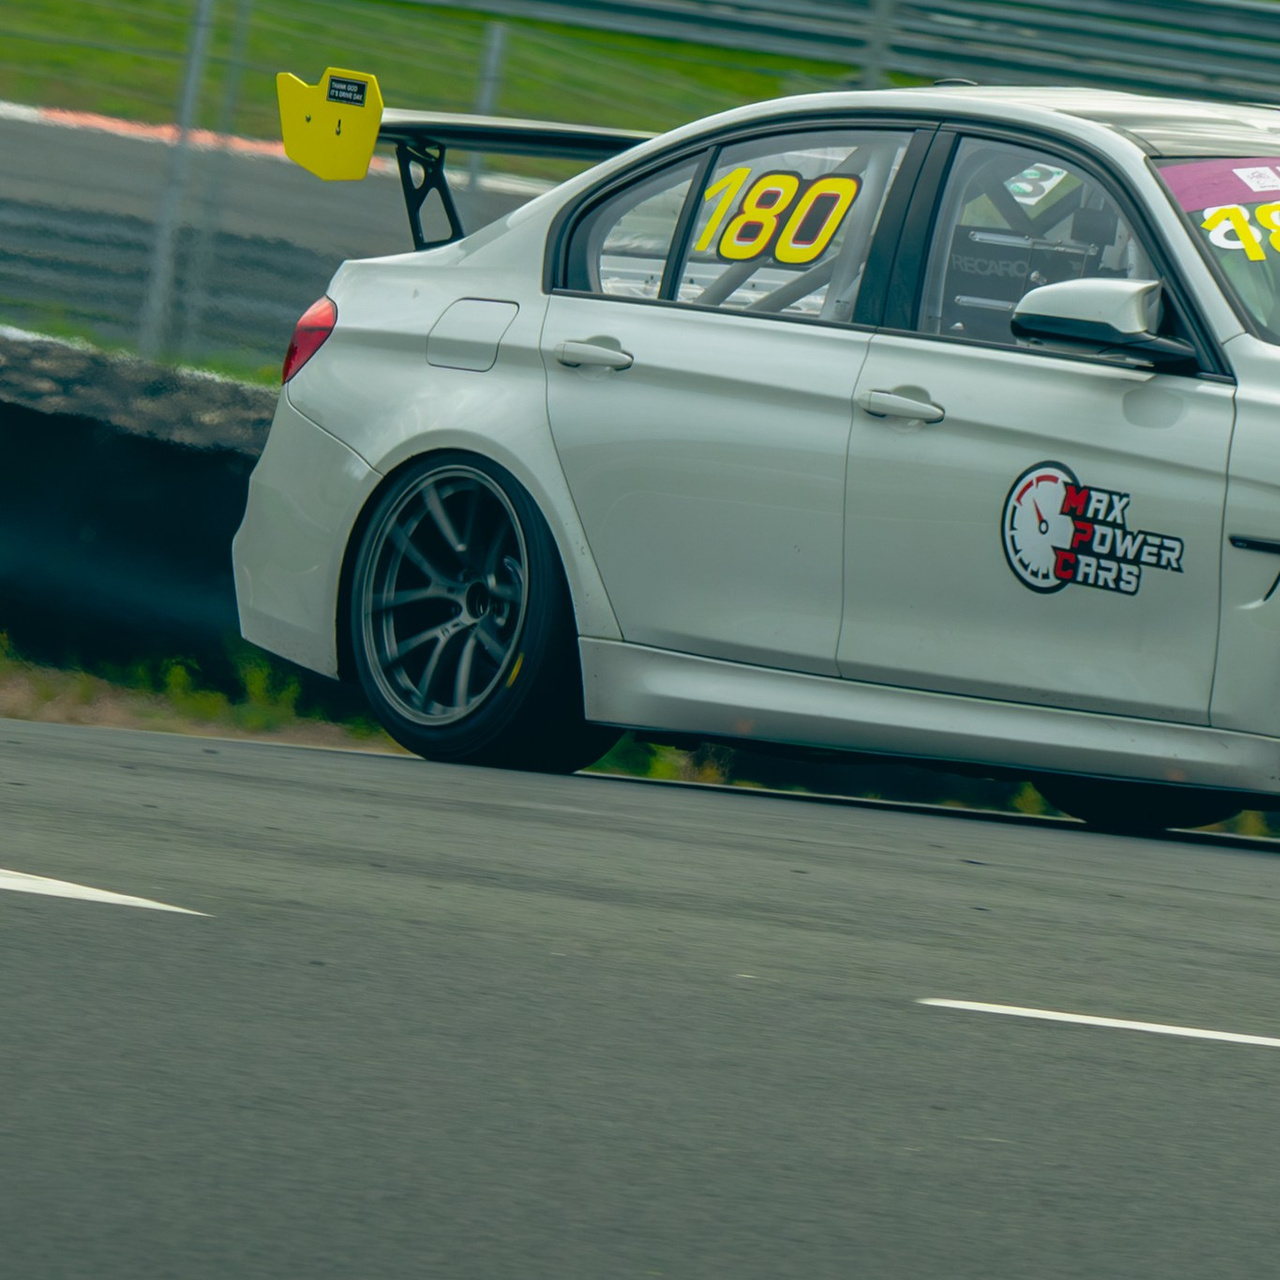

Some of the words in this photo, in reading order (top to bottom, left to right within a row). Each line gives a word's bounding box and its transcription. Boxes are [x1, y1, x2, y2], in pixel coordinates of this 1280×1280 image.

[332, 82, 346, 90] THANK
[339, 91, 352, 99] DRIVE
[694, 167, 860, 265] 180
[951, 253, 1029, 278] RECARO
[1062, 484, 1130, 525] MAX
[1071, 520, 1182, 569] POWER
[1055, 549, 1140, 593] CARS
